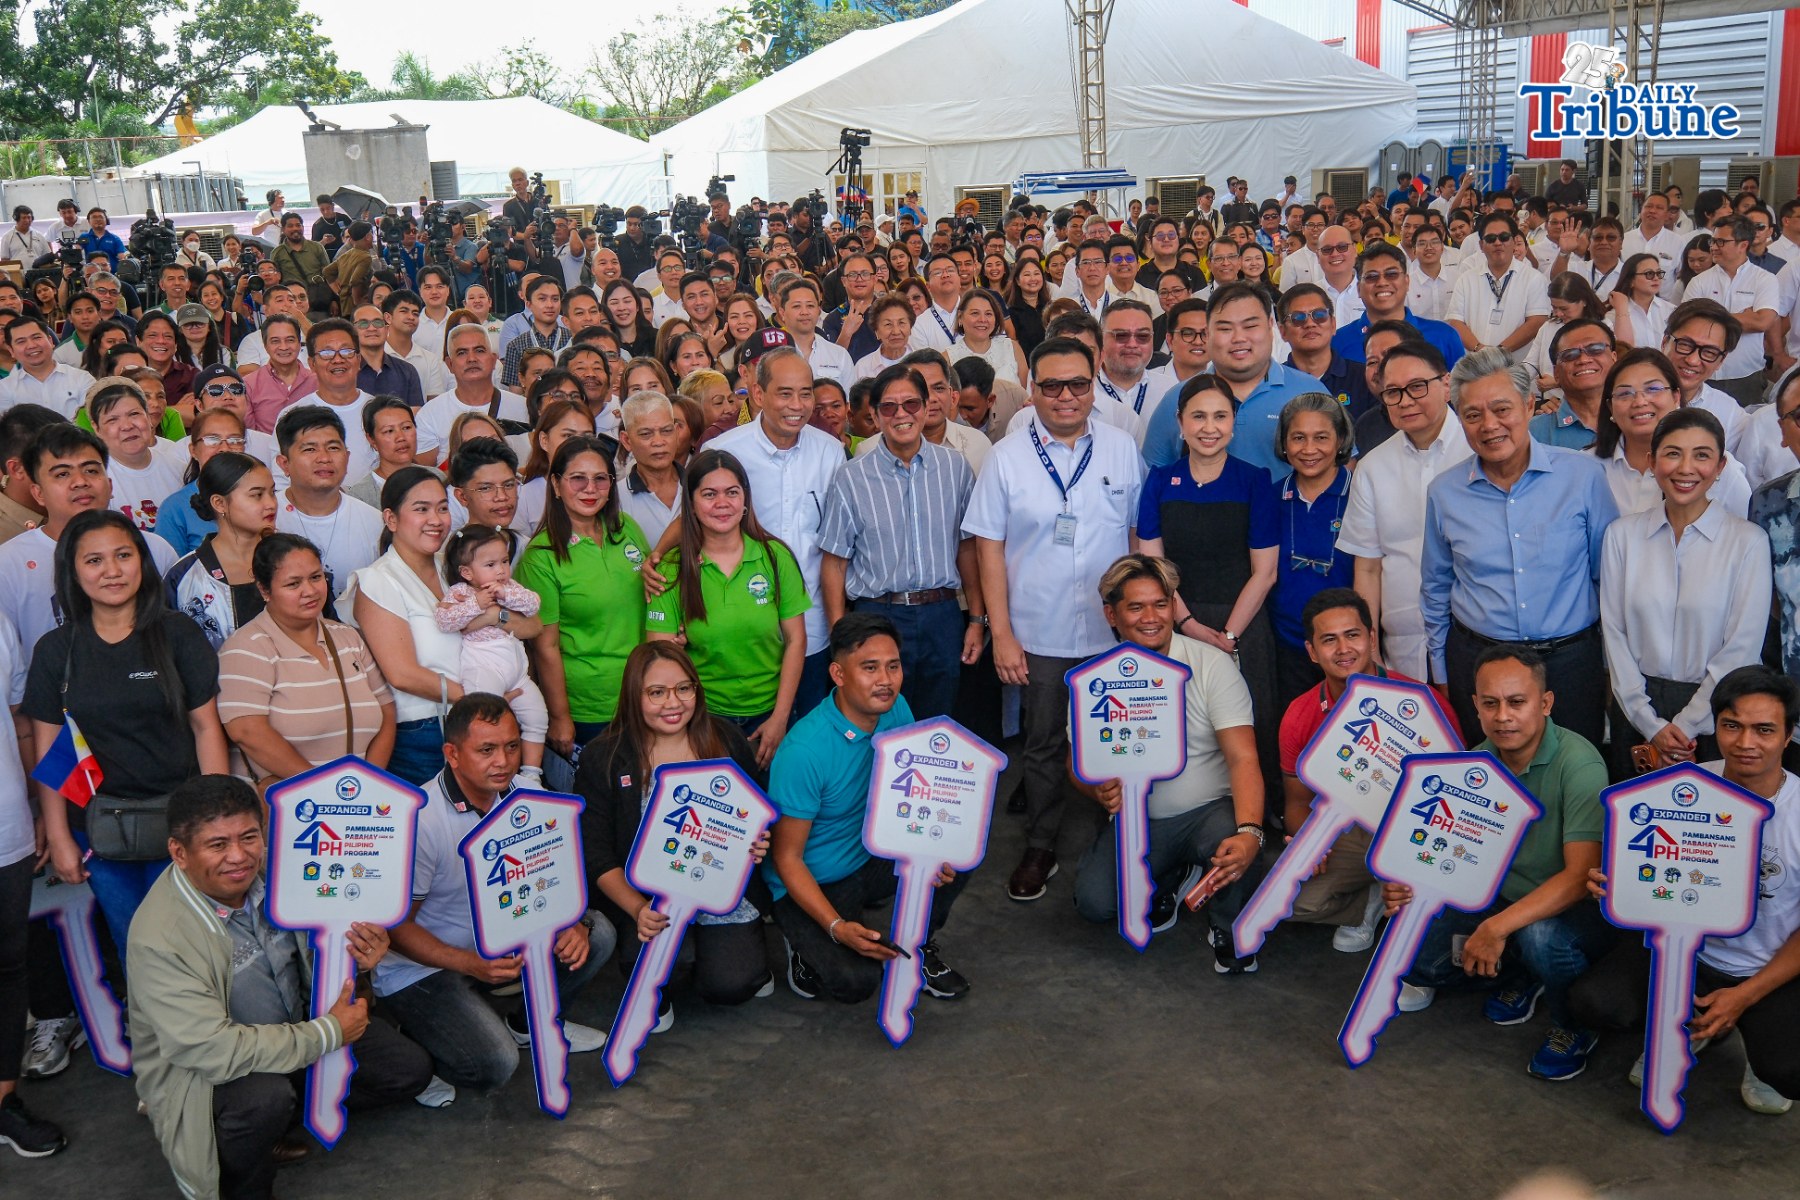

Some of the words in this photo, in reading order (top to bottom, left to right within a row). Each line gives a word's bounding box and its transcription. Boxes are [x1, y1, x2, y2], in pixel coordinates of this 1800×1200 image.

[764, 330, 786, 345] UP
[1106, 681, 1146, 689] EXPANDED
[1090, 695, 1128, 722] 4PH
[1376, 709, 1414, 737] EXPANDED
[1343, 718, 1380, 756] 4PH
[1387, 736, 1412, 754] PAMBAN
[913, 755, 956, 768] EXPANDED
[1374, 754, 1400, 774] PROGRAM
[1379, 748, 1400, 766] PILIPINO
[890, 768, 931, 800] 4PH
[933, 782, 961, 791] PABAHAY
[934, 775, 976, 786] PAMBANSANG
[931, 796, 961, 805] PROGRAM
[932, 789, 958, 798] PILIPINO
[1442, 784, 1488, 806] EXPANDED
[318, 806, 369, 815] EXPANDED
[691, 793, 731, 814] EXPANDED
[1410, 796, 1455, 833] 4PH
[1460, 809, 1505, 830] PAMBANSANG
[1653, 810, 1707, 822] EXPANDED
[663, 805, 703, 841] 4PH
[705, 824, 732, 837] PABAHAY
[707, 817, 746, 835] PAMBANSANG
[1454, 823, 1481, 836] PILIPINO
[1458, 816, 1487, 831] PABAHAY
[293, 821, 342, 856] 4PH
[500, 828, 540, 847] EXPANDED
[703, 831, 726, 842] PILIPINO
[1452, 830, 1483, 845] PROGRAM
[1628, 824, 1679, 861] 4PH
[1682, 832, 1736, 842] PAMBANSANG
[1682, 839, 1717, 848] PABAHAY
[524, 836, 563, 855] PAMBANSANG
[701, 838, 728, 851] PROGRAM
[1681, 847, 1713, 856] PILIPINO
[525, 848, 551, 862] PABAHAY
[526, 856, 549, 869] PILIPINO
[1681, 855, 1719, 864] PROGRAM
[486, 854, 525, 887] 4PH
[527, 862, 555, 876] PROGRAM
